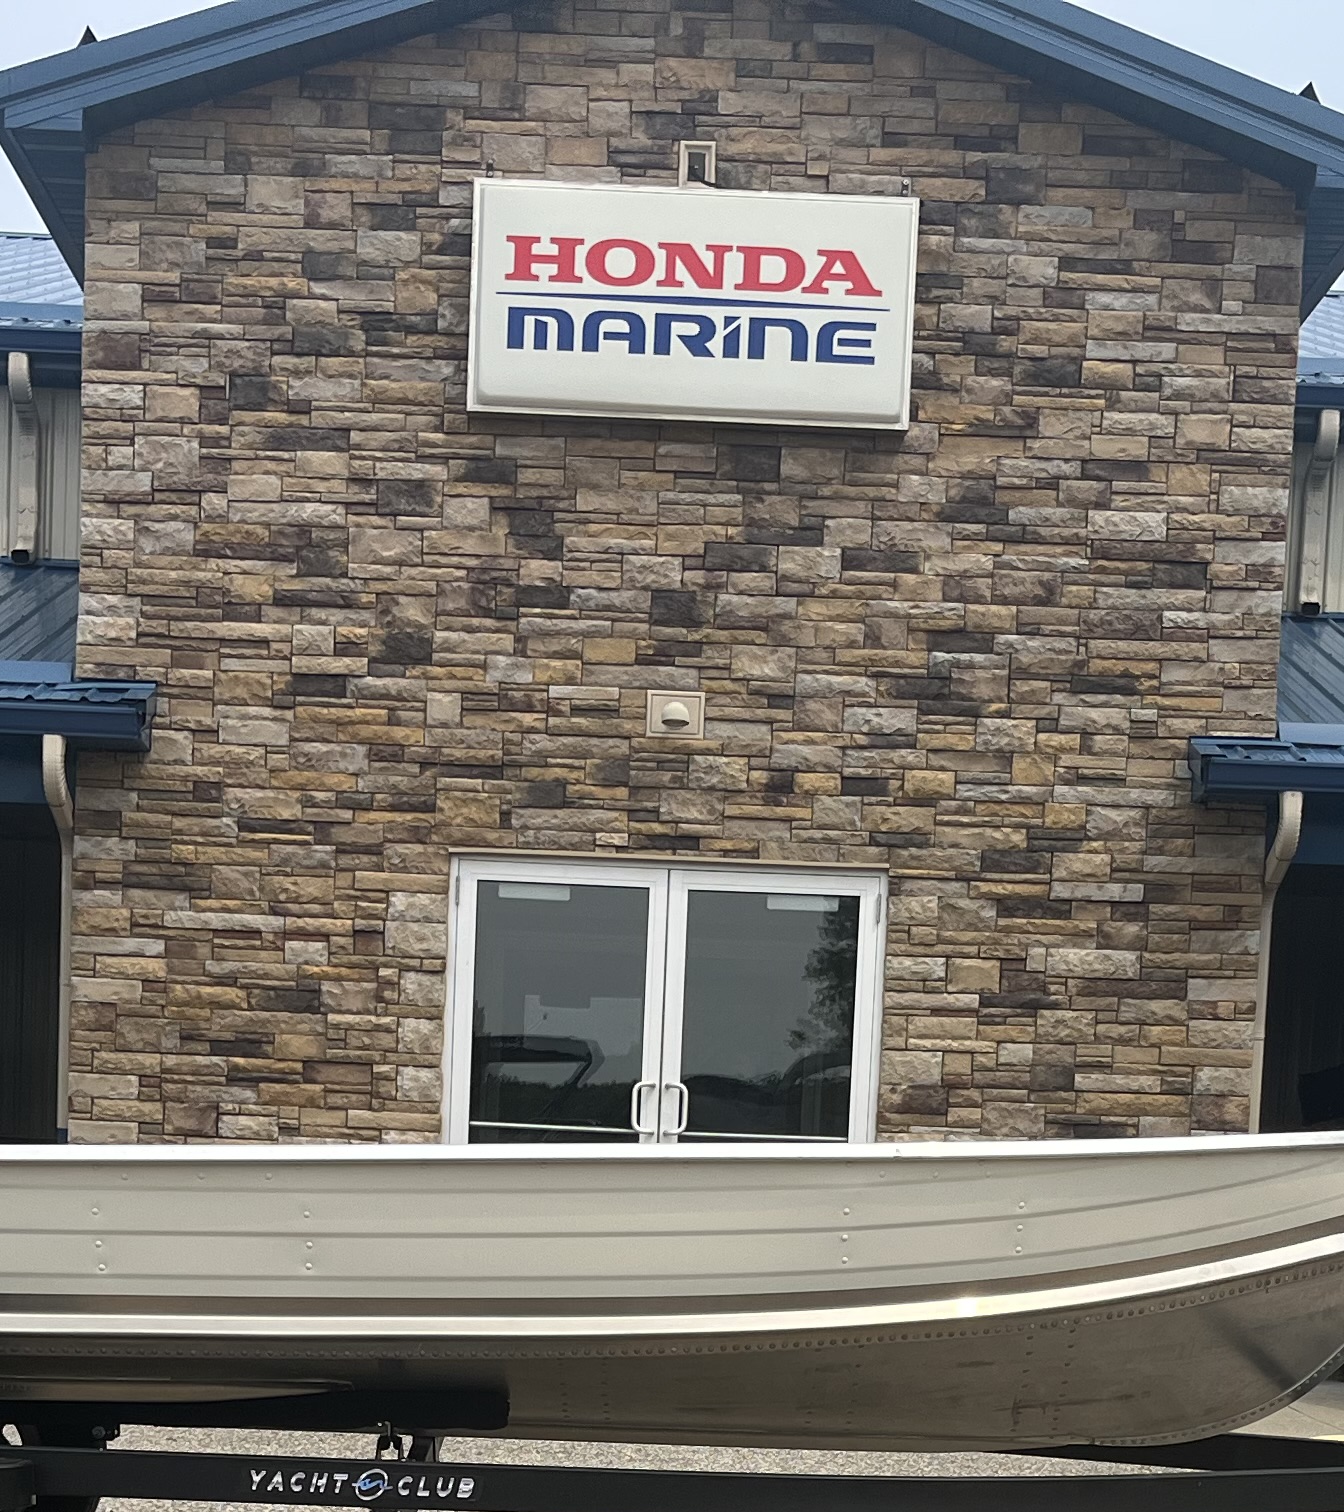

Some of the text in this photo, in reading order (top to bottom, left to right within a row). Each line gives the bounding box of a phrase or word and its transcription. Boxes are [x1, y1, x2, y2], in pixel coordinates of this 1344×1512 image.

[504, 235, 883, 297] HONDA
[250, 1469, 476, 1499] YACHT CLUB
